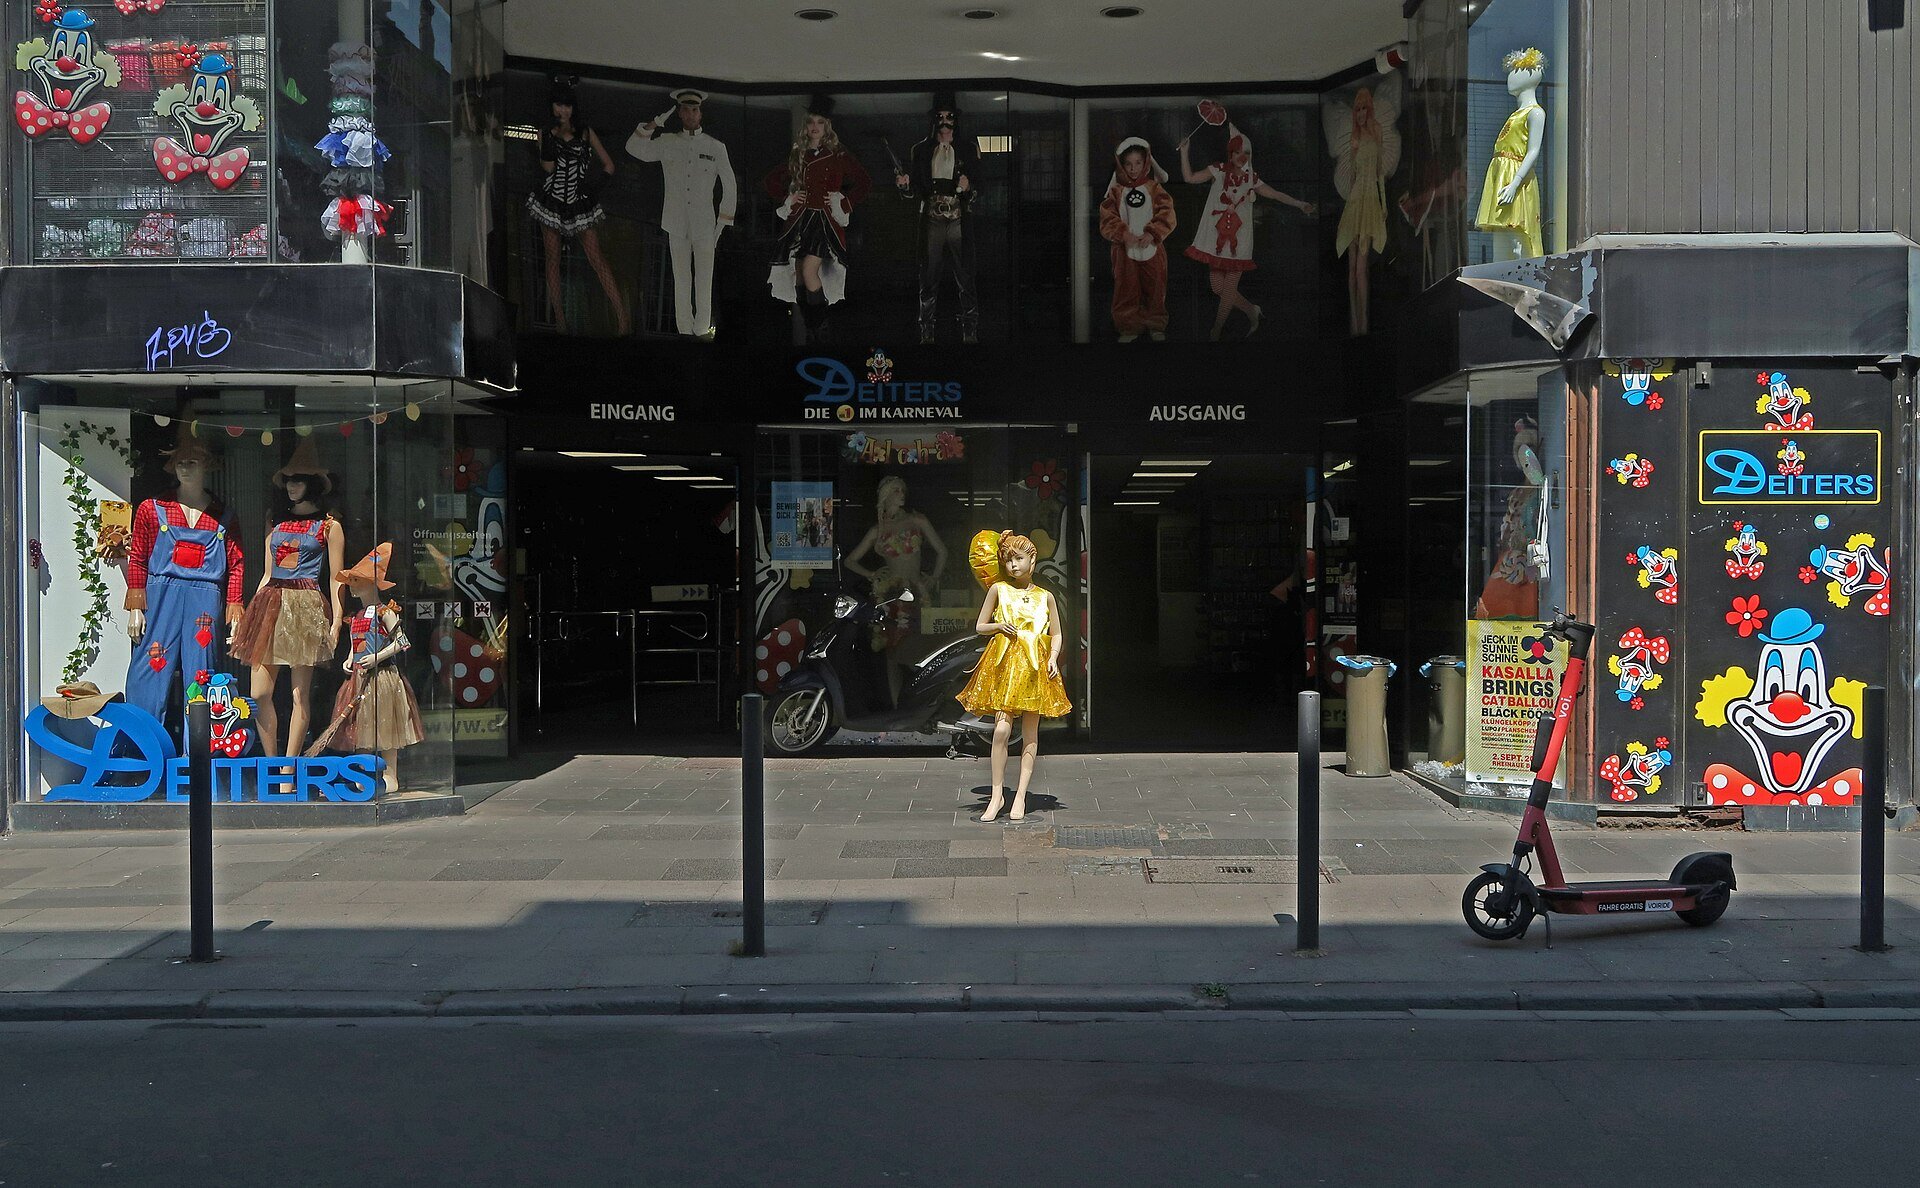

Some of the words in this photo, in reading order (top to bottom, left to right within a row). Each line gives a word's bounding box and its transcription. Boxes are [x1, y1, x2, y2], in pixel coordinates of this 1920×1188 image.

[795, 356, 963, 403] DEITERS
[590, 402, 676, 421] EINGANG
[804, 407, 831, 419] DIE
[859, 407, 877, 419] IM
[881, 406, 963, 419] KARNEVAL
[1149, 404, 1247, 422] AUSGANG
[1705, 448, 1874, 495] DEITERS
[933, 618, 954, 626] JECK
[1481, 635, 1506, 644] JECK
[1507, 635, 1518, 644] IM
[1482, 644, 1518, 654] SUNNE
[1482, 653, 1518, 663] SCHING
[1482, 665, 1554, 681] KASALLA
[1482, 679, 1554, 697] BRINGS
[1481, 695, 1507, 706] CAT
[1508, 696, 1554, 708] BALLOU
[1558, 695, 1573, 718] voi.
[1481, 706, 1518, 718] BLÄCK
[1521, 707, 1554, 719] FÖÖ
[1481, 718, 1531, 726] KLÜNGELKÖPP
[1500, 754, 1523, 762] SEPT.
[1598, 903, 1619, 912] FAHRE
[1620, 902, 1644, 911] GRATIS
